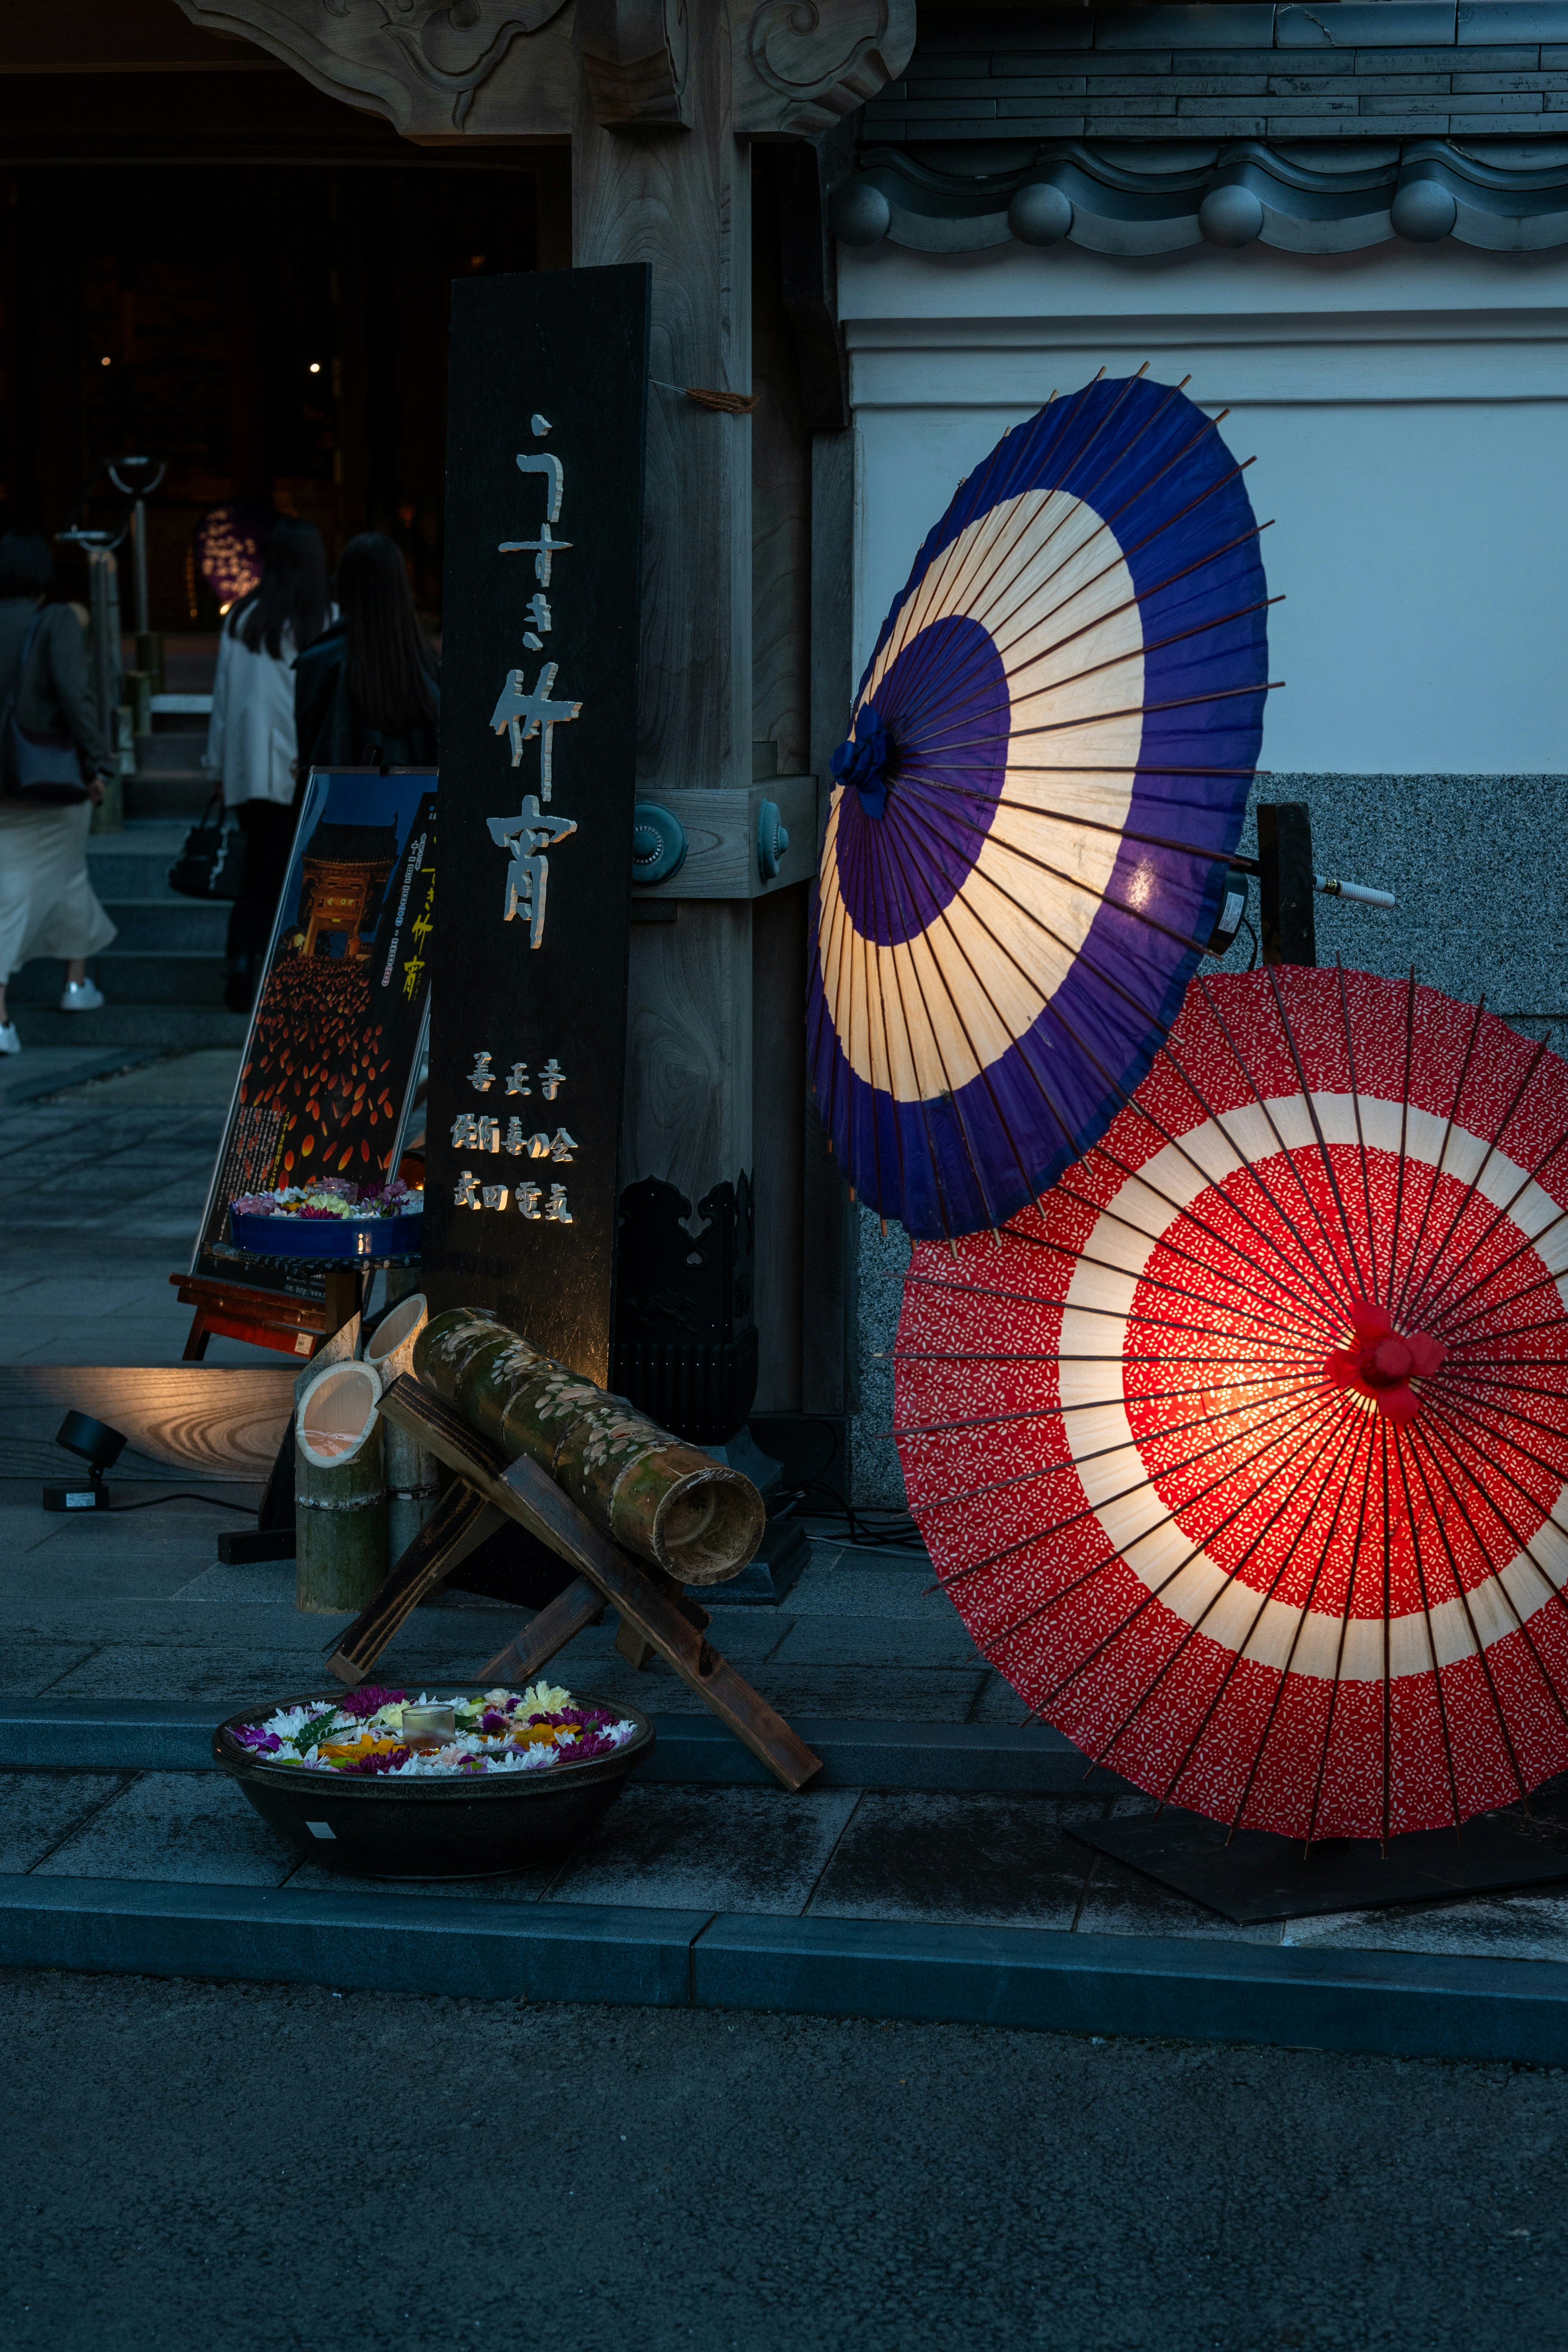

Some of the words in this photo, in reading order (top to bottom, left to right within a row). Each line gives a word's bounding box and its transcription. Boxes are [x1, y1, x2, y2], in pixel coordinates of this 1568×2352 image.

[486, 414, 583, 949] うすき竹宵
